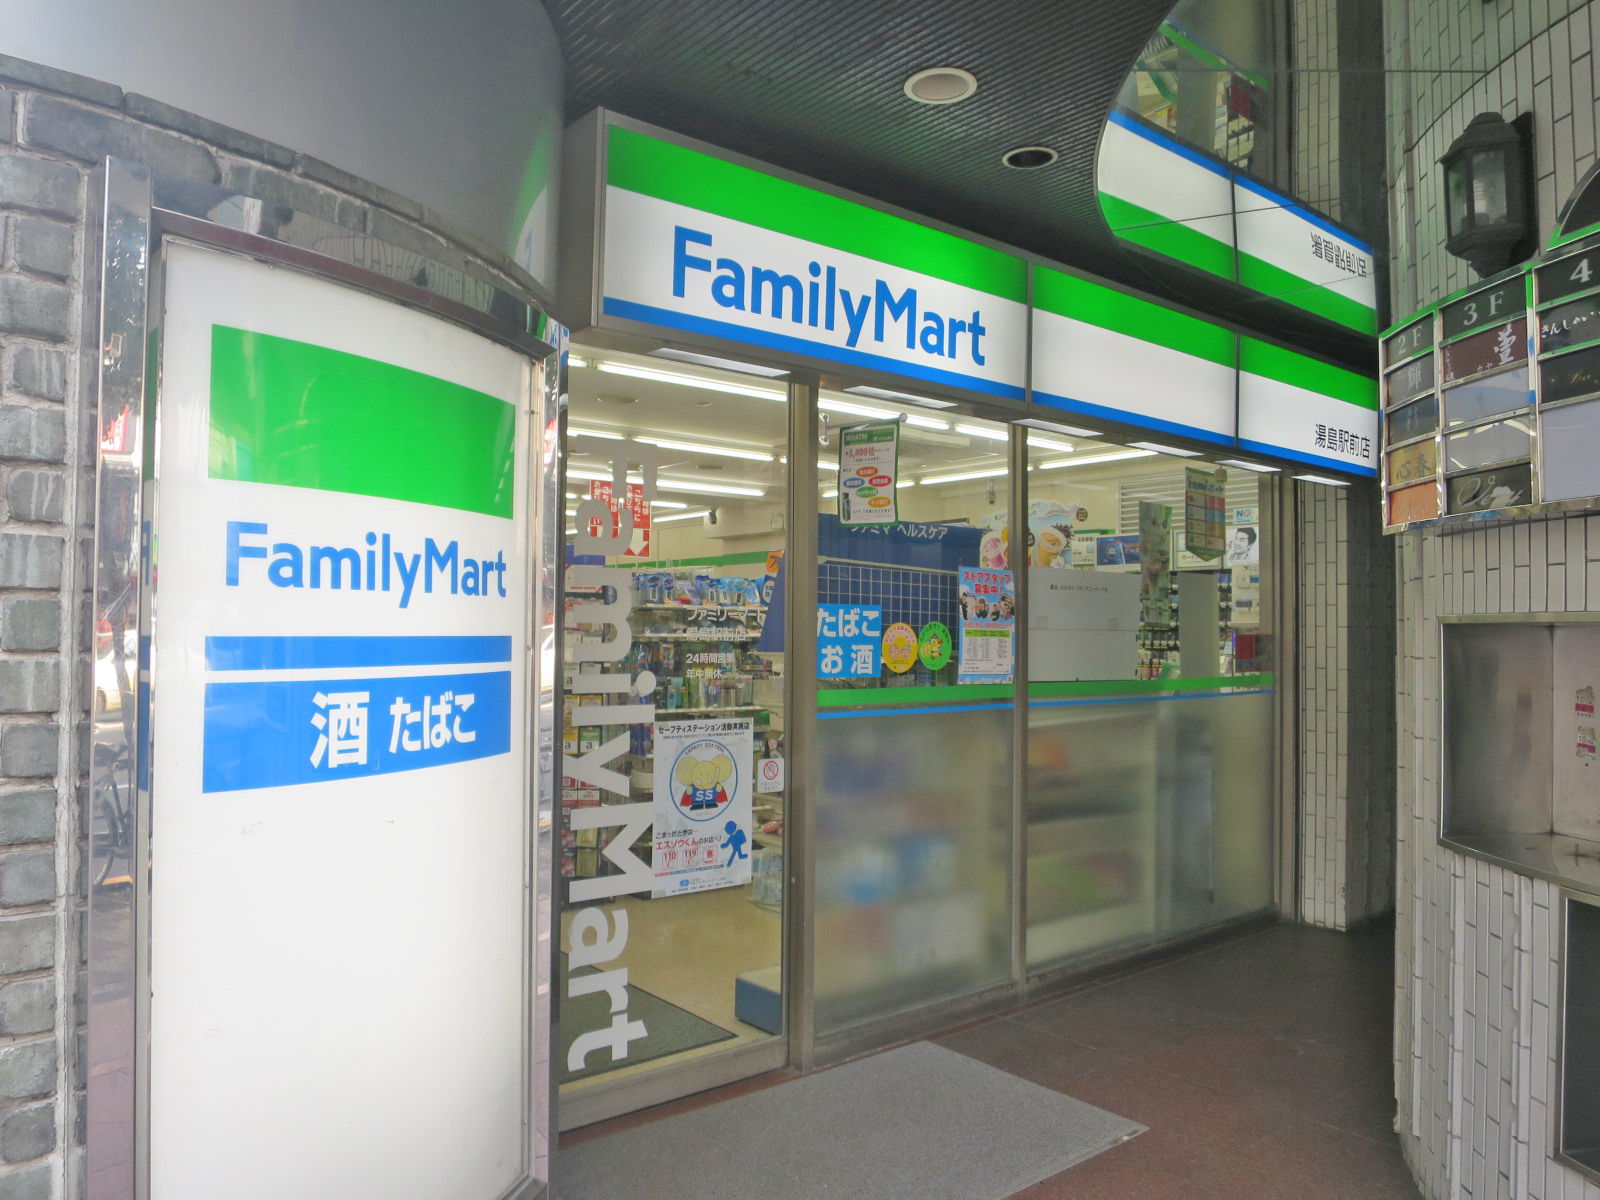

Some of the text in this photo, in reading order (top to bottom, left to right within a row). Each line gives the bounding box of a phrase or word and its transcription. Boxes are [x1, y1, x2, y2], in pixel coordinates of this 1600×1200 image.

[1569, 258, 1593, 283] 4
[673, 225, 986, 366] FamilyMart
[1314, 423, 1371, 460] 湯島駅前店
[896, 525, 949, 540] ヘルスケア
[225, 520, 507, 609] FamilyMart
[962, 570, 1012, 584] ストアスタッフ
[687, 608, 767, 622] ファミリーマート
[816, 607, 881, 638] たばこ
[686, 653, 736, 665] 24時間営業
[820, 644, 874, 675] お酒
[686, 668, 722, 680] 年中無休
[309, 690, 477, 770] 酒 たばこ
[562, 434, 658, 1073] FamilyMart
[695, 789, 714, 801] SS
[663, 852, 677, 862] 110
[684, 849, 697, 859] 119
